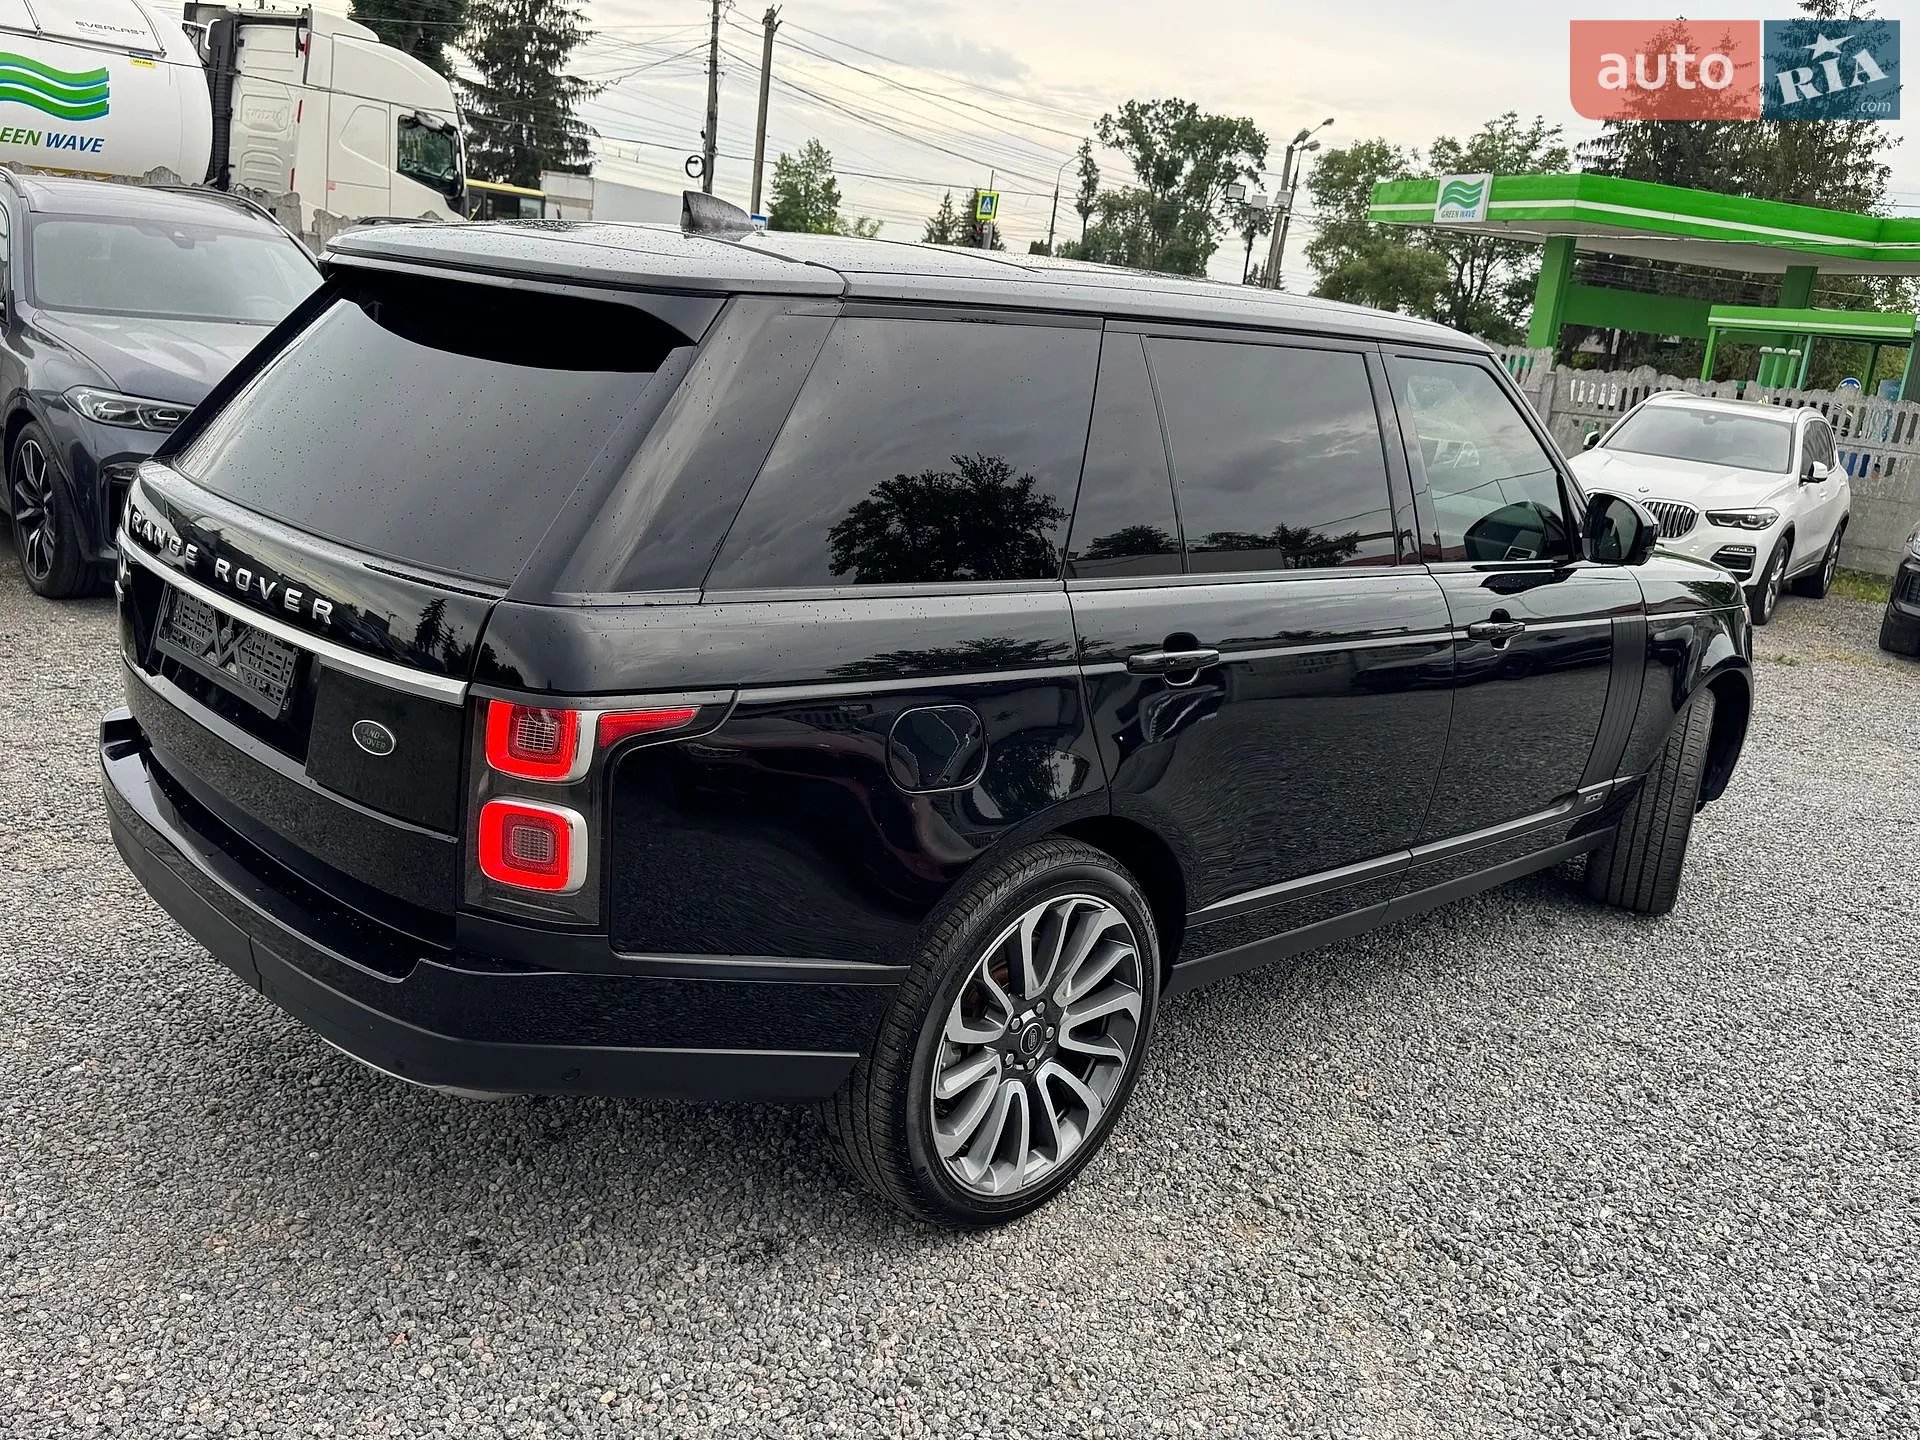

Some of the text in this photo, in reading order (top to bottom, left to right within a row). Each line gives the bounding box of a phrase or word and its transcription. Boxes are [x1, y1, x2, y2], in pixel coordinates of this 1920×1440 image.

[46, 132, 105, 153] WAVE
[1441, 209, 1460, 218] GREEN
[130, 511, 334, 625] RANGE ROVER
